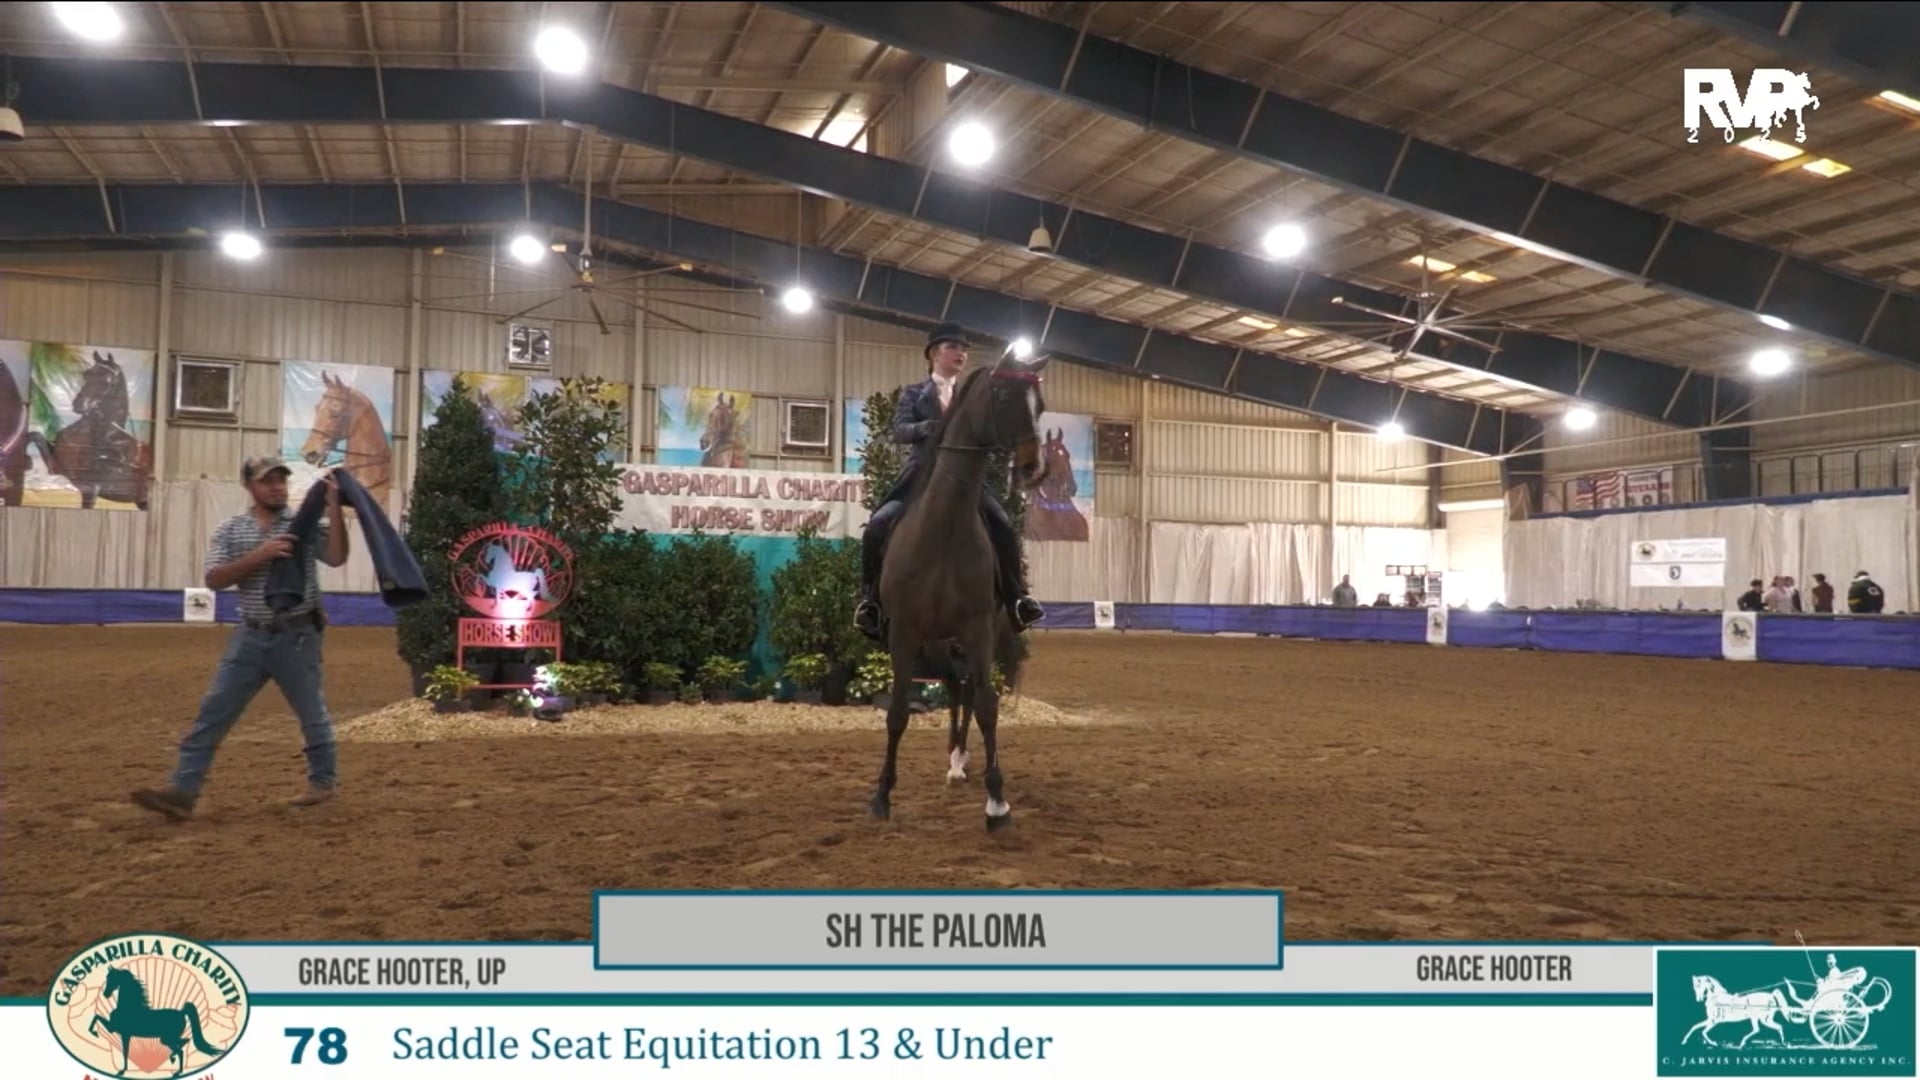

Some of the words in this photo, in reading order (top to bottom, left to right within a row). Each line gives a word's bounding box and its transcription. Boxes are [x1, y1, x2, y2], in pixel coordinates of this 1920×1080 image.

[623, 469, 771, 500] GASPARILLA
[671, 505, 755, 530] HORSE
[761, 508, 831, 532] SHOW
[464, 623, 511, 643] HORSE
